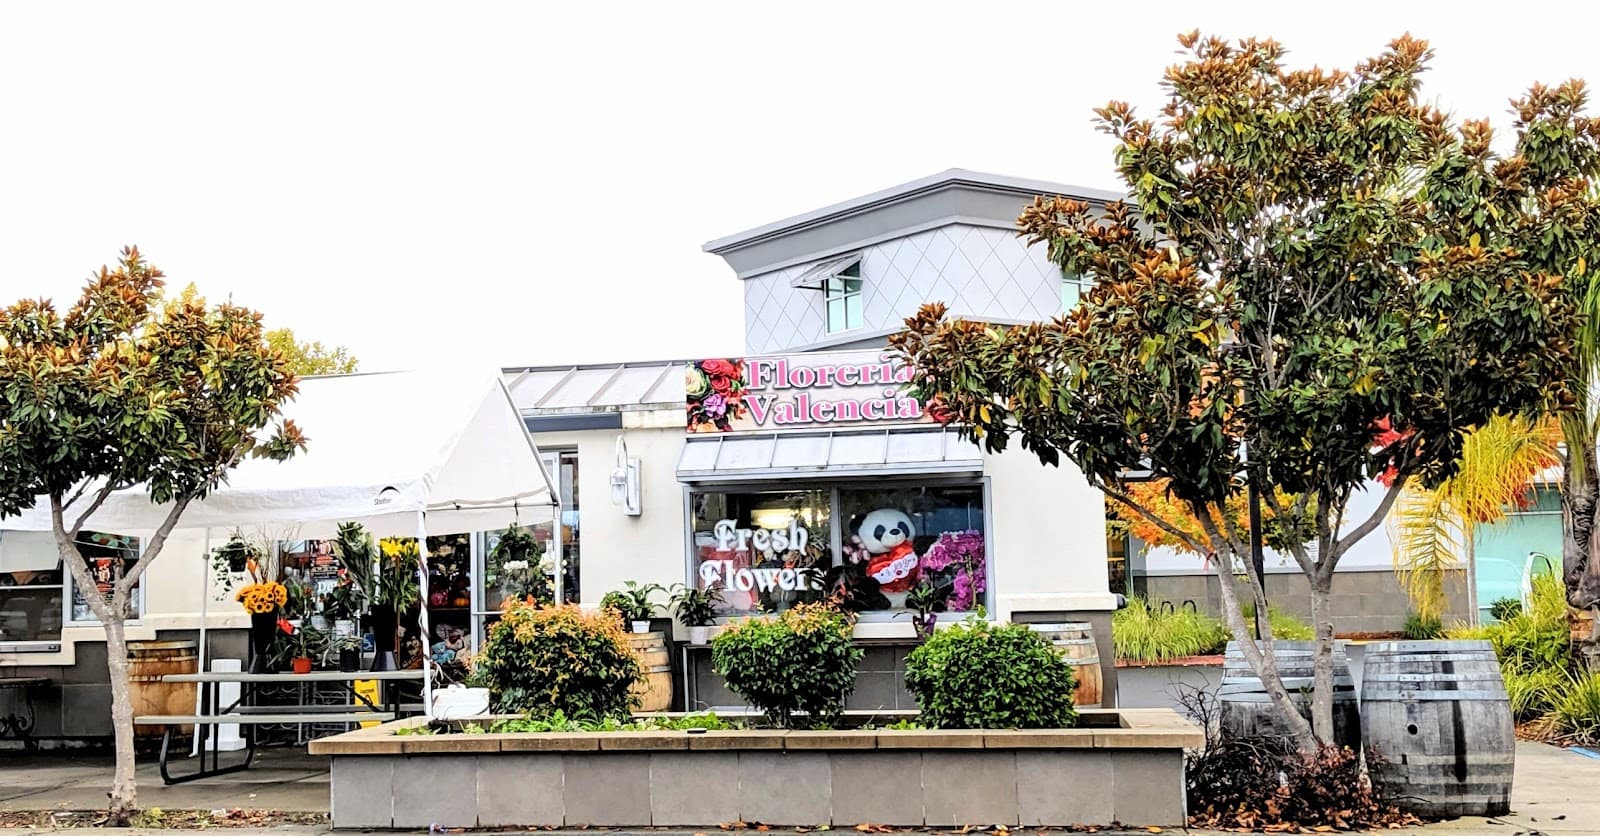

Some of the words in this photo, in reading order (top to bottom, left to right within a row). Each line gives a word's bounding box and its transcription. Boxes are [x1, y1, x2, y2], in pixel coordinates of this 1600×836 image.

[745, 353, 917, 391] Floreria
[743, 389, 923, 426] Valencia
[714, 518, 809, 557] Fresh
